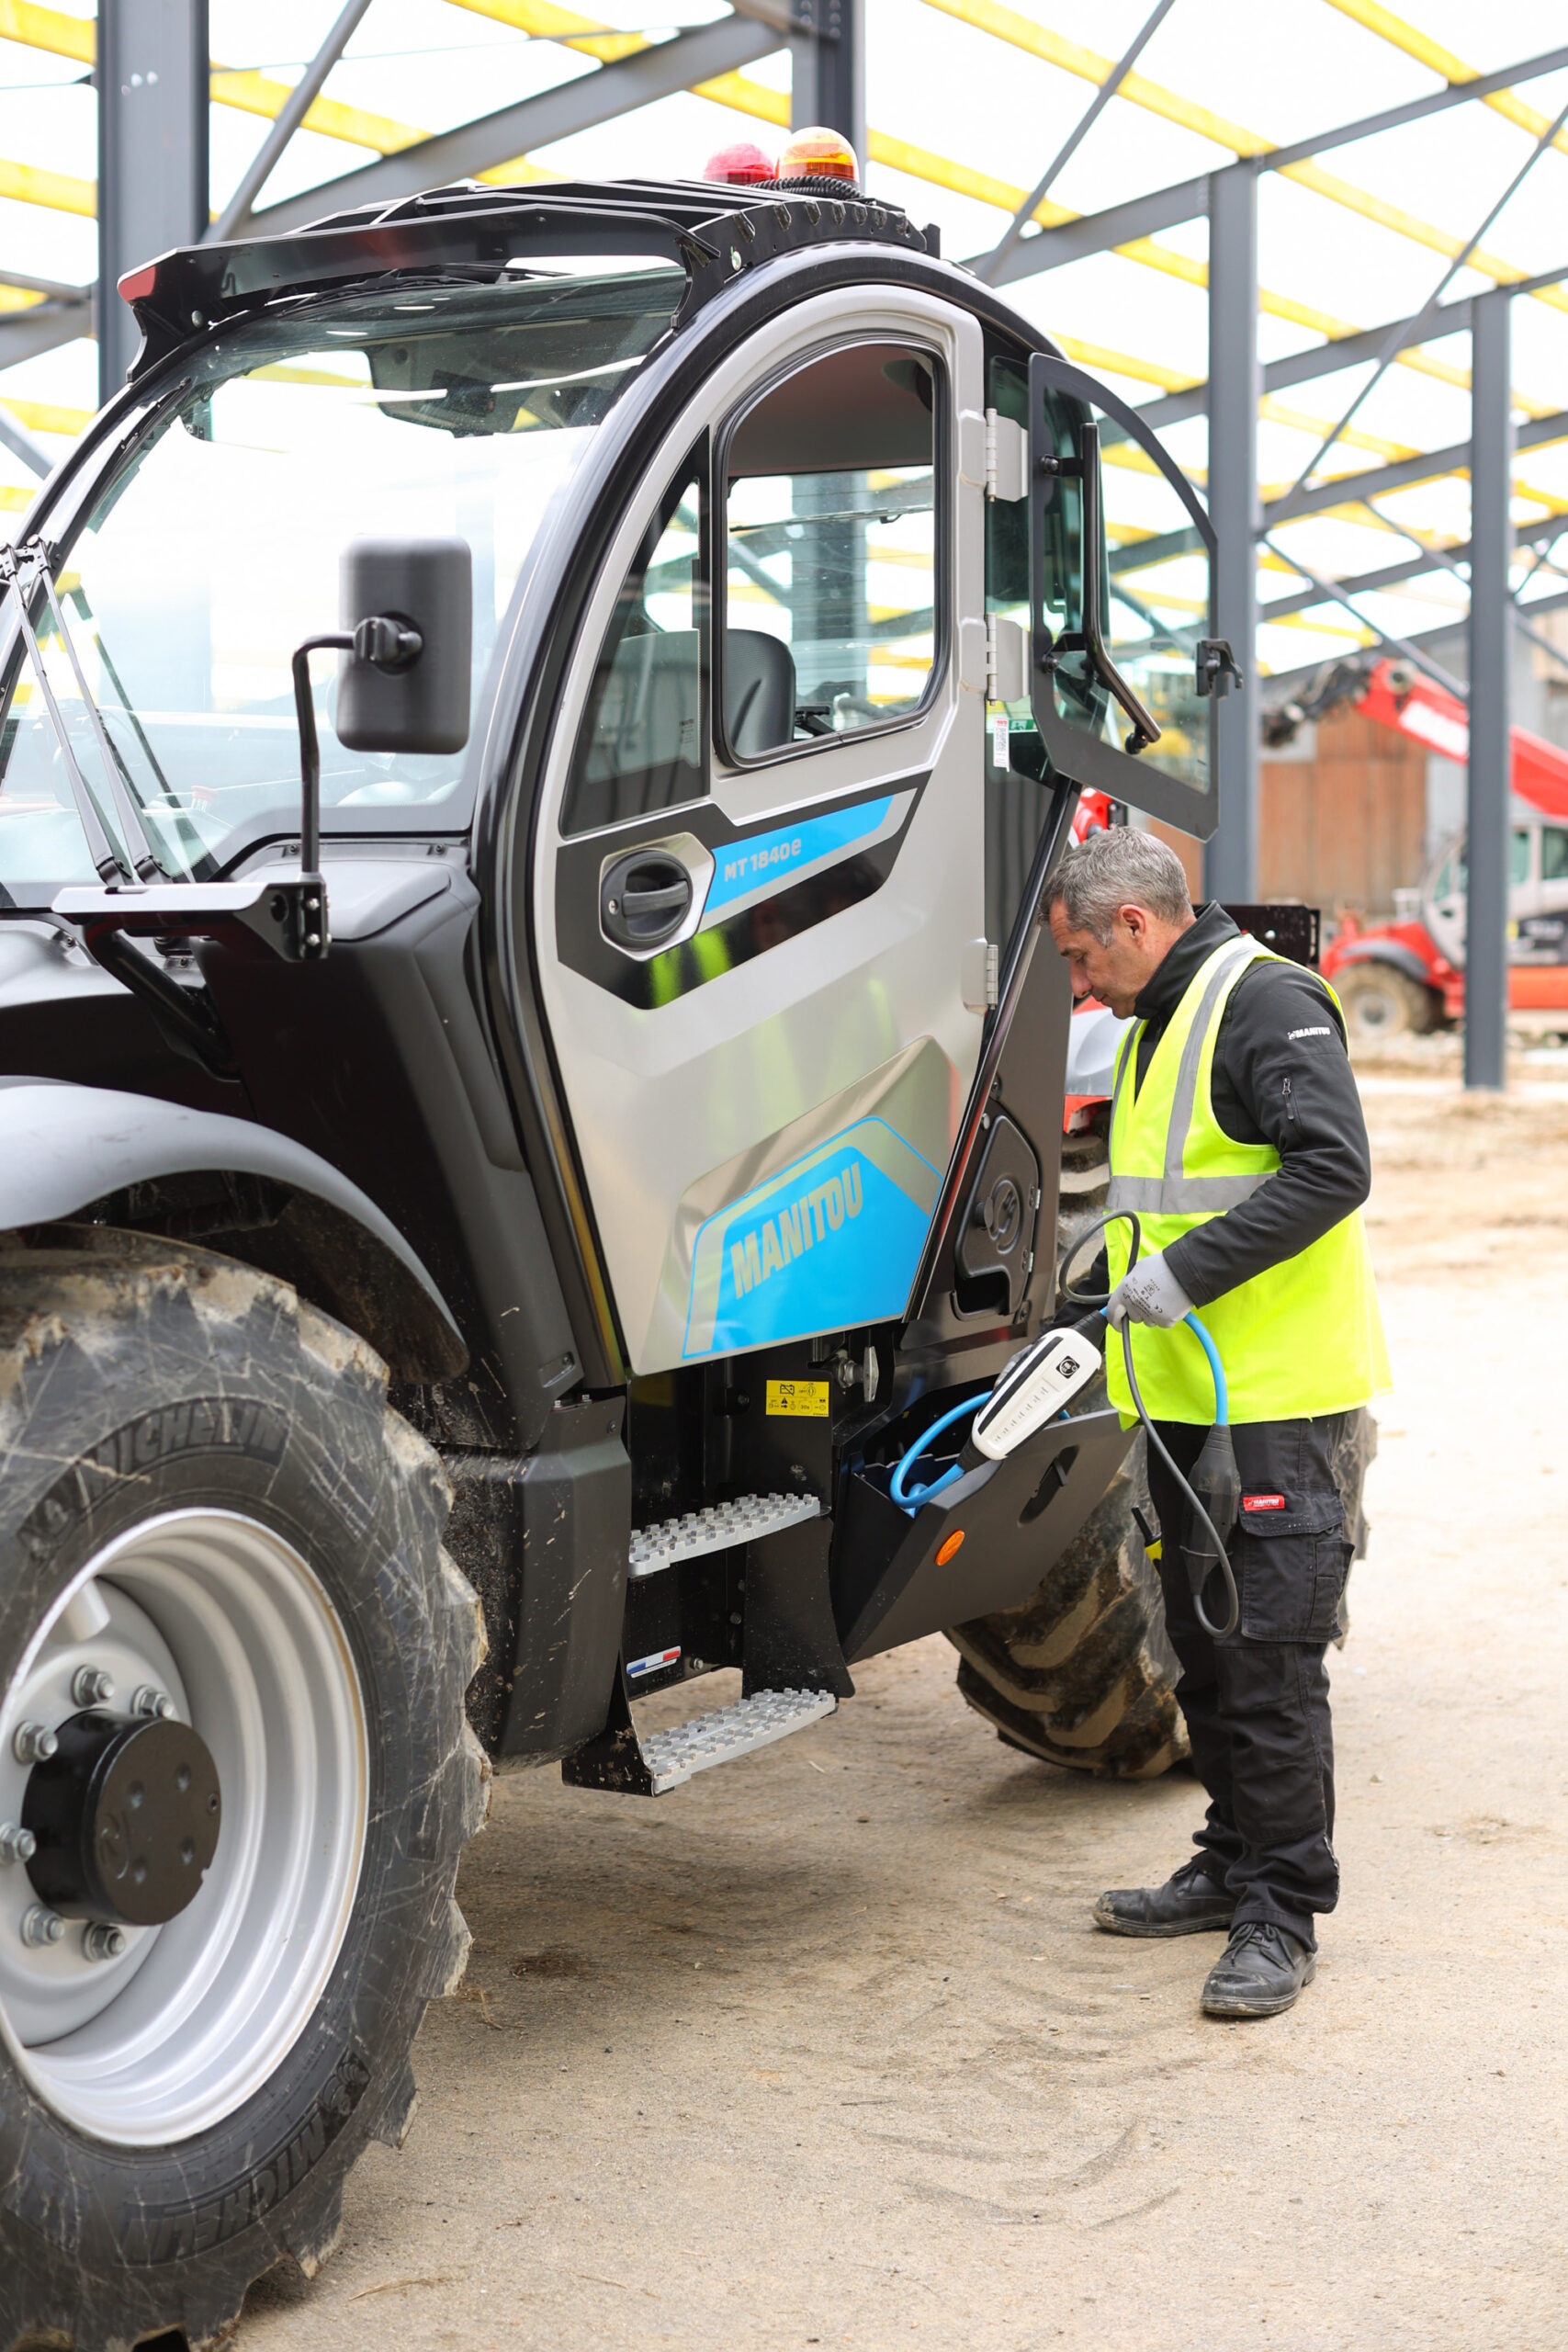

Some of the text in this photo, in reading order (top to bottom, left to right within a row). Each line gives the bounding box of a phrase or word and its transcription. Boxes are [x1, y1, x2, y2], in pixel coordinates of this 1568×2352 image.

[725, 838, 801, 882] MT 1840e
[1294, 1026, 1330, 1038] MANITOU
[730, 1161, 863, 1299] MANITOU
